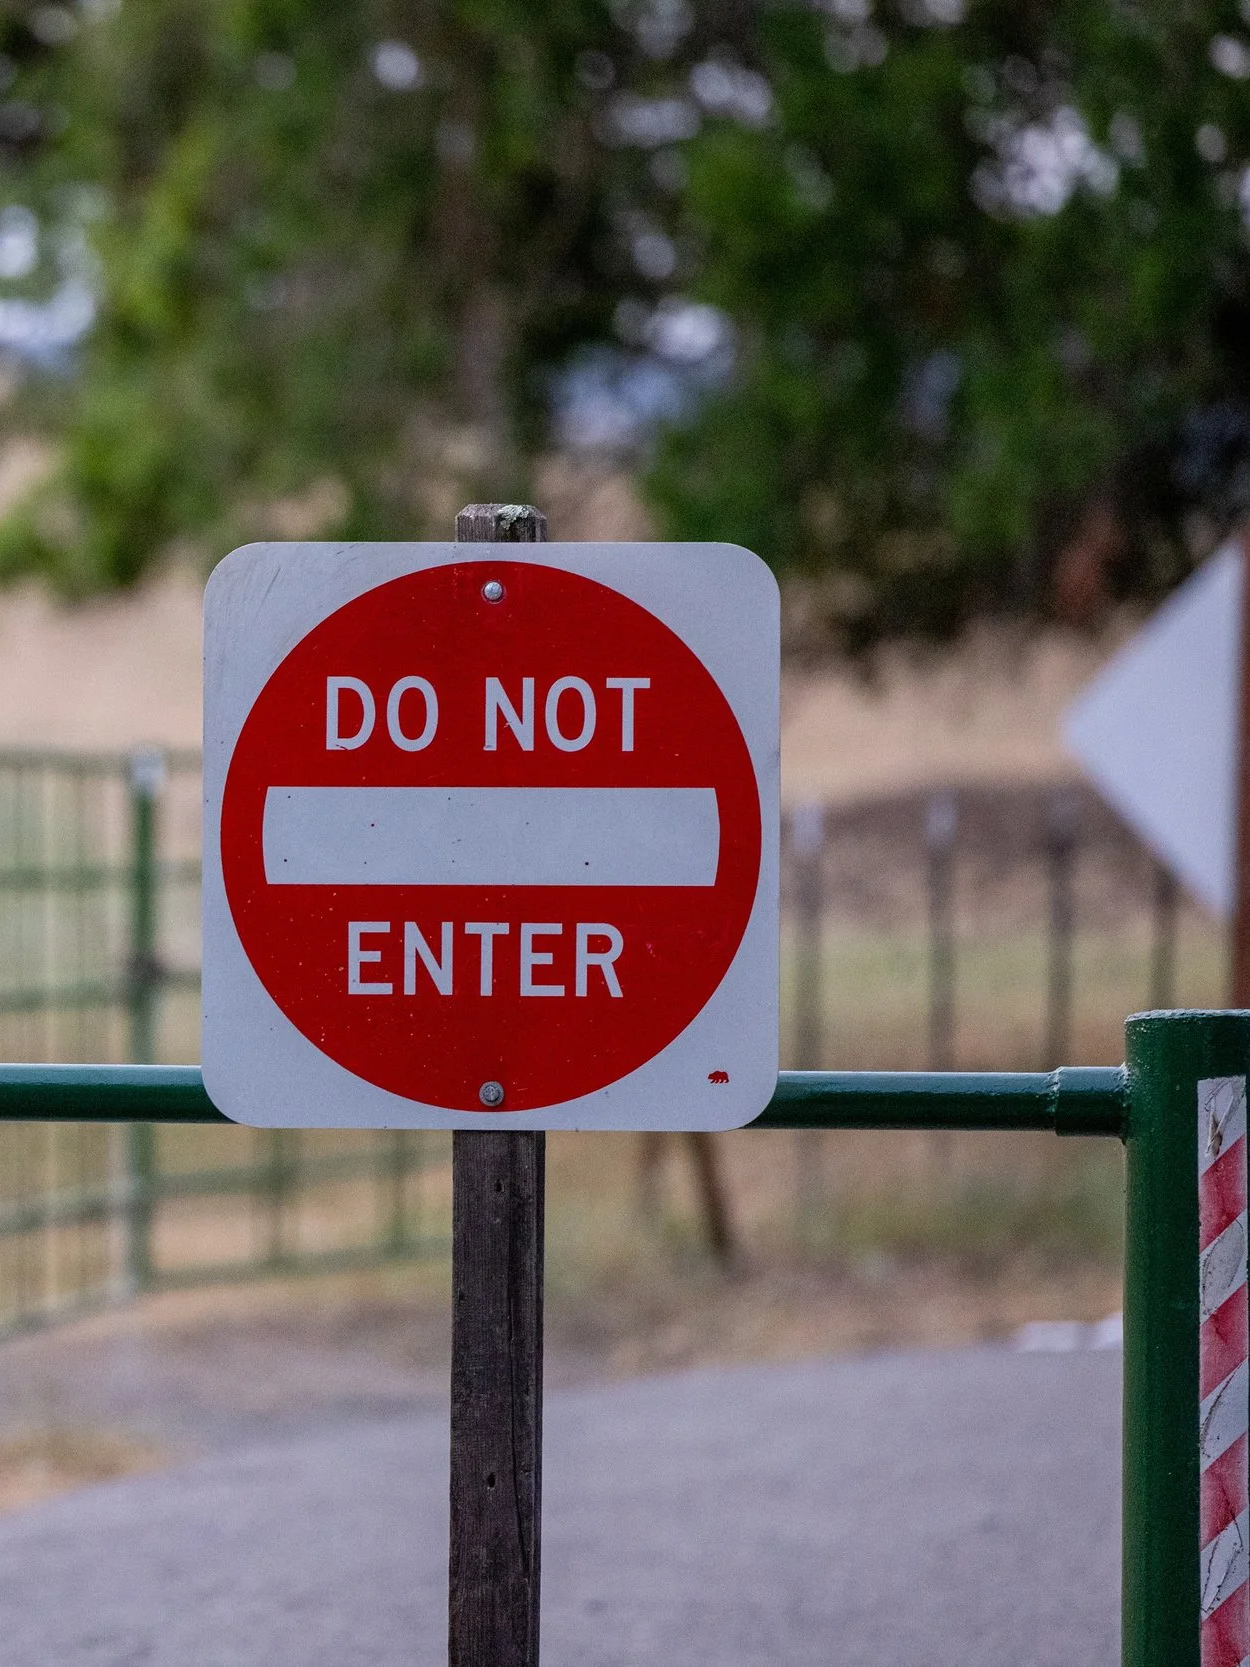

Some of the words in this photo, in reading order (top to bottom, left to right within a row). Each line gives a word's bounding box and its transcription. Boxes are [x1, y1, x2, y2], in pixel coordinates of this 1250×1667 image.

[326, 676, 439, 752] DO
[483, 676, 651, 752] NOT
[347, 921, 625, 998] ENTER
